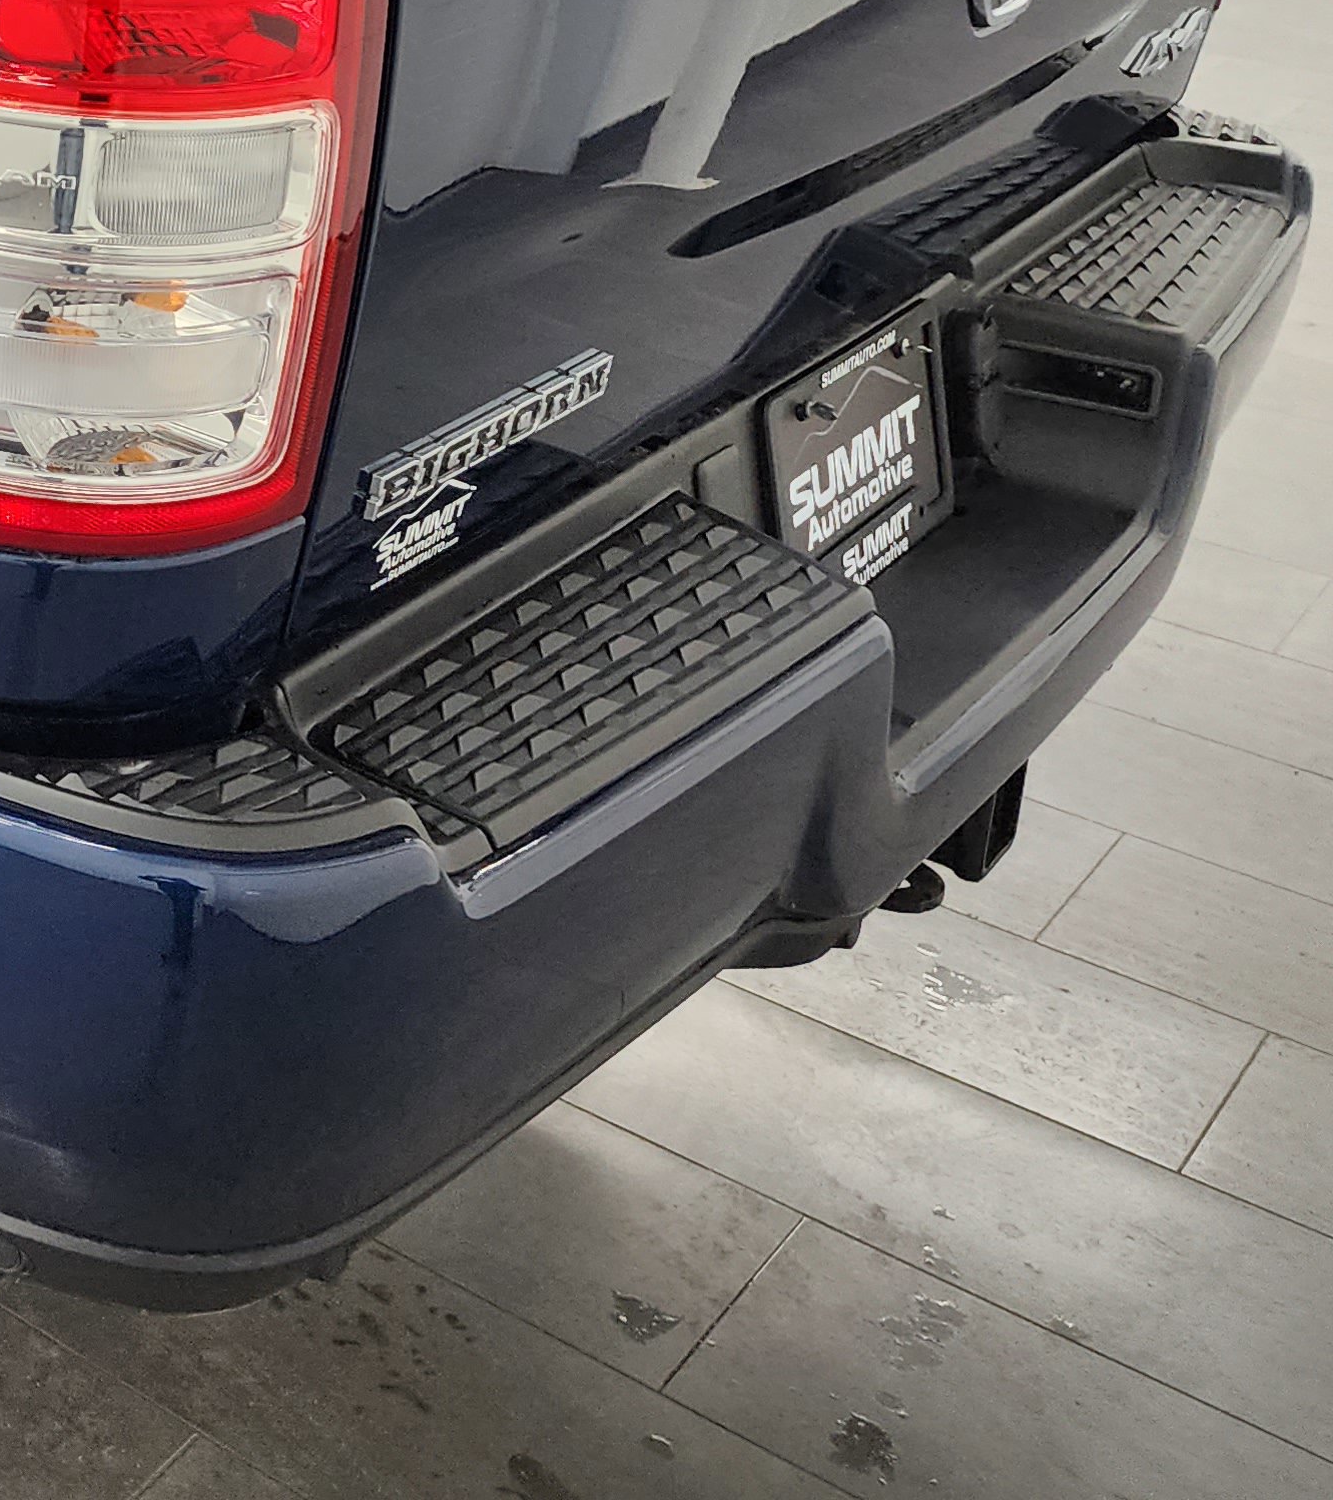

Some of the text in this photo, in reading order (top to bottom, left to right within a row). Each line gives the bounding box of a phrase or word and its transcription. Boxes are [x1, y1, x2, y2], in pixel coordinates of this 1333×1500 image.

[821, 330, 896, 388] SUMMITAUTO.COM
[790, 395, 920, 528] SUMMIT
[376, 491, 474, 563] SUMMIT
[808, 453, 913, 551] Automotive
[379, 522, 456, 573] Automotive
[842, 503, 912, 578] SUMMIT
[852, 536, 909, 586] Automotive
